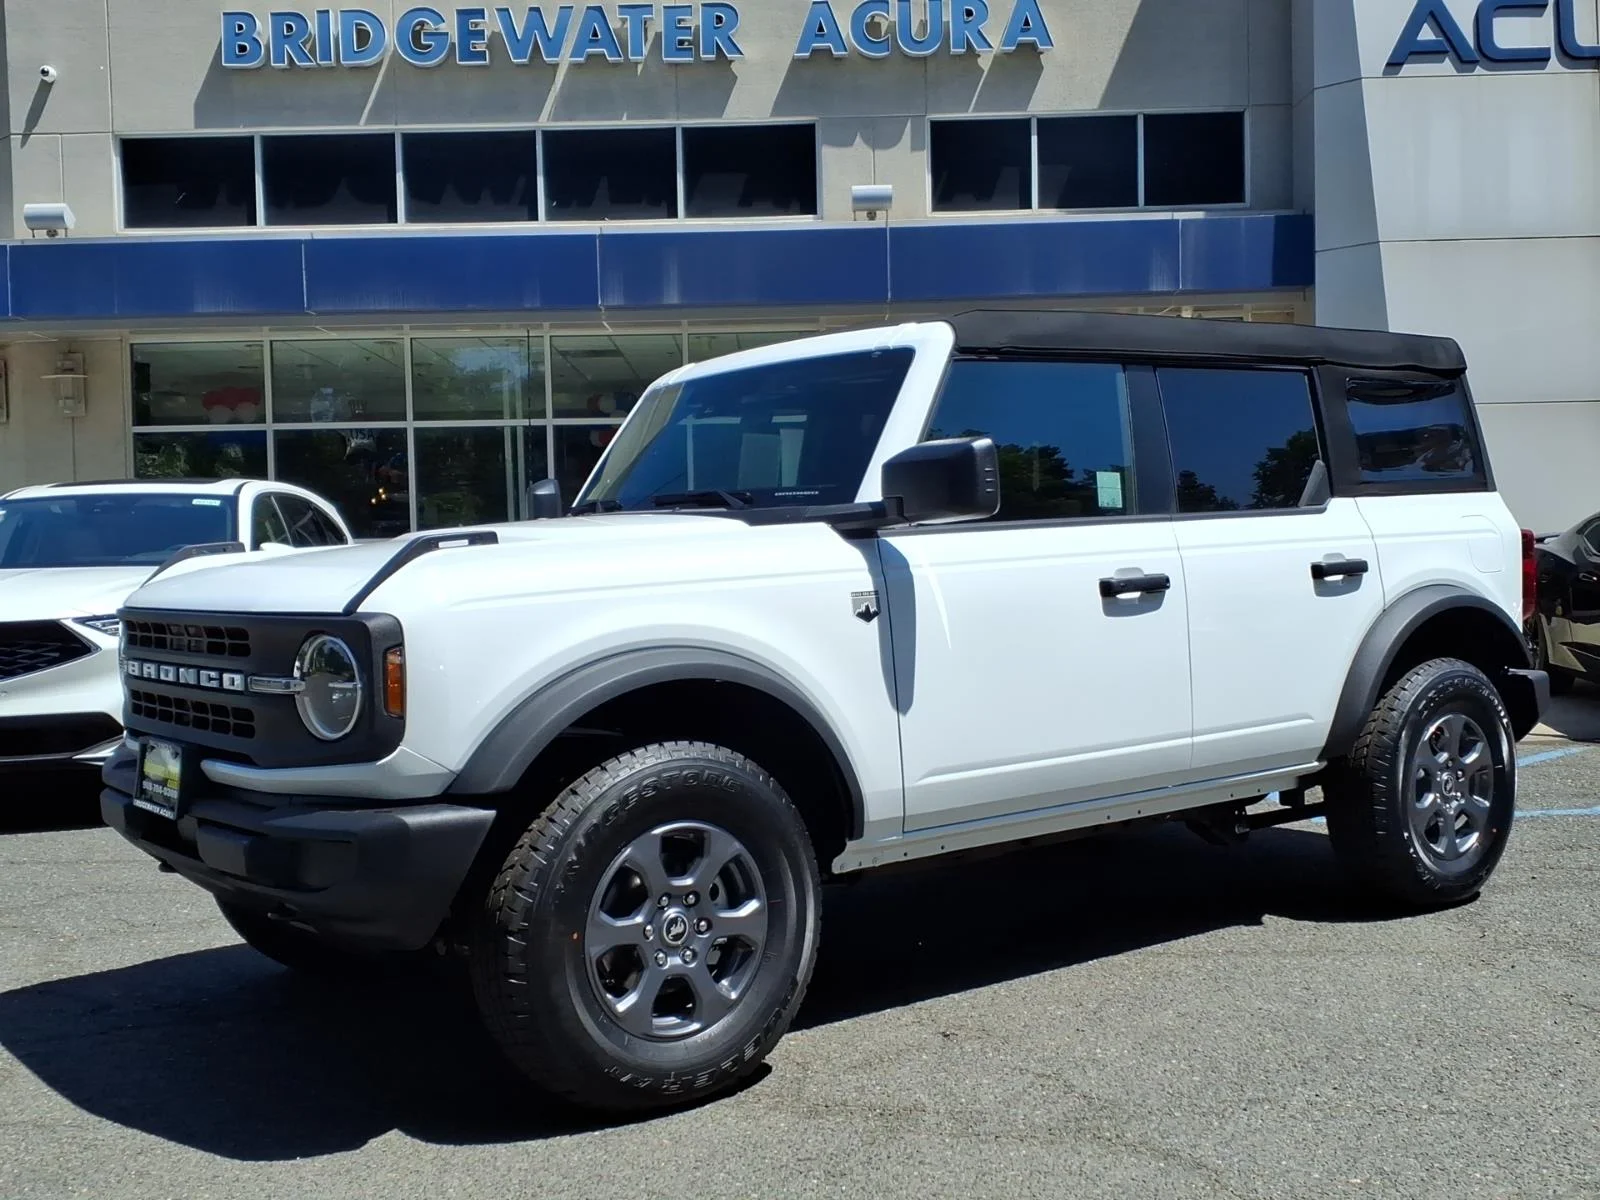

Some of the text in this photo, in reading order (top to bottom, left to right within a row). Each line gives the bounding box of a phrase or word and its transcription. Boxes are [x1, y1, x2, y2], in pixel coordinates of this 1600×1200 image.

[221, 0, 1055, 69] BRIDGEWATER ACURA
[1384, 0, 1600, 67] ACU
[127, 660, 246, 692] BRONCO
